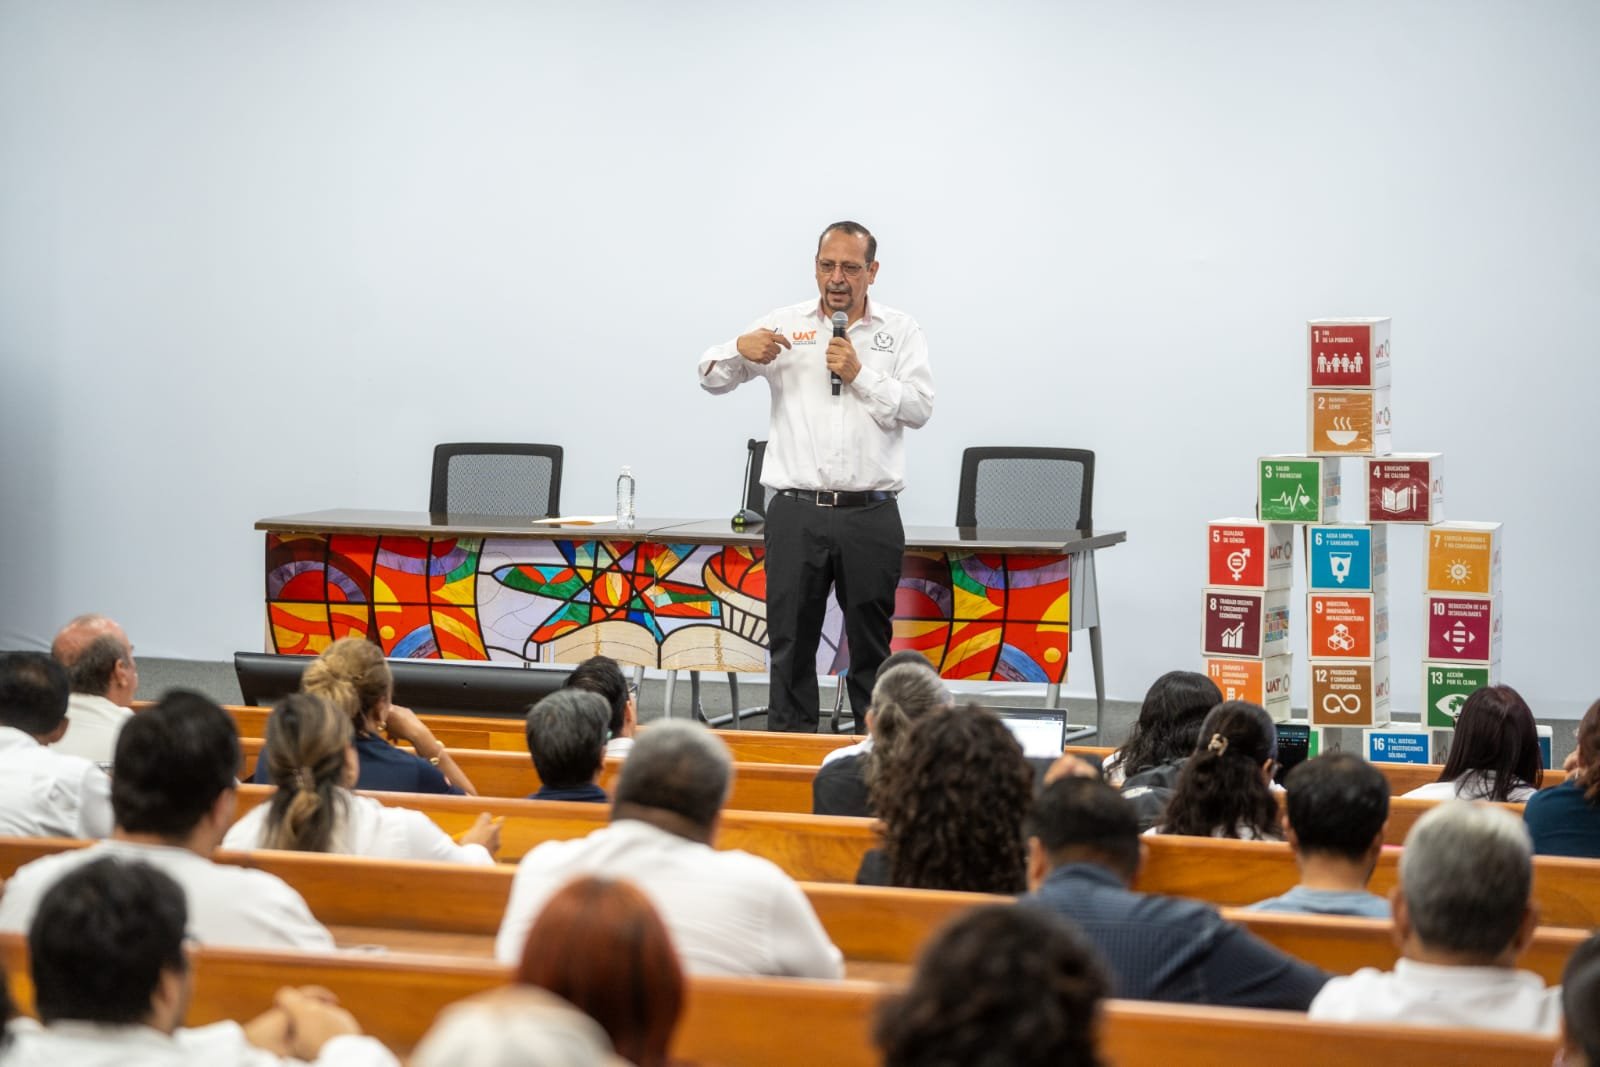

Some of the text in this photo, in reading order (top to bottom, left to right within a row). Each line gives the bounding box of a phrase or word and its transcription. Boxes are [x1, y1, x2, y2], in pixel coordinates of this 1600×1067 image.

[792, 330, 817, 341] UAT
[1313, 330, 1319, 343] 1
[1318, 397, 1326, 410] 2
[1265, 465, 1273, 478] 3
[1373, 465, 1381, 478] 4
[1213, 530, 1220, 543] 5
[1315, 533, 1322, 545] 6
[1434, 535, 1441, 548] 7
[1270, 544, 1283, 560] UAT
[1210, 598, 1217, 611] 8
[1315, 601, 1323, 614] 9
[1433, 602, 1445, 616] 10
[1211, 664, 1220, 677] 11
[1315, 669, 1327, 683] 12
[1430, 671, 1443, 685] 13
[1266, 678, 1281, 694] UAT
[1373, 737, 1385, 751] 16
